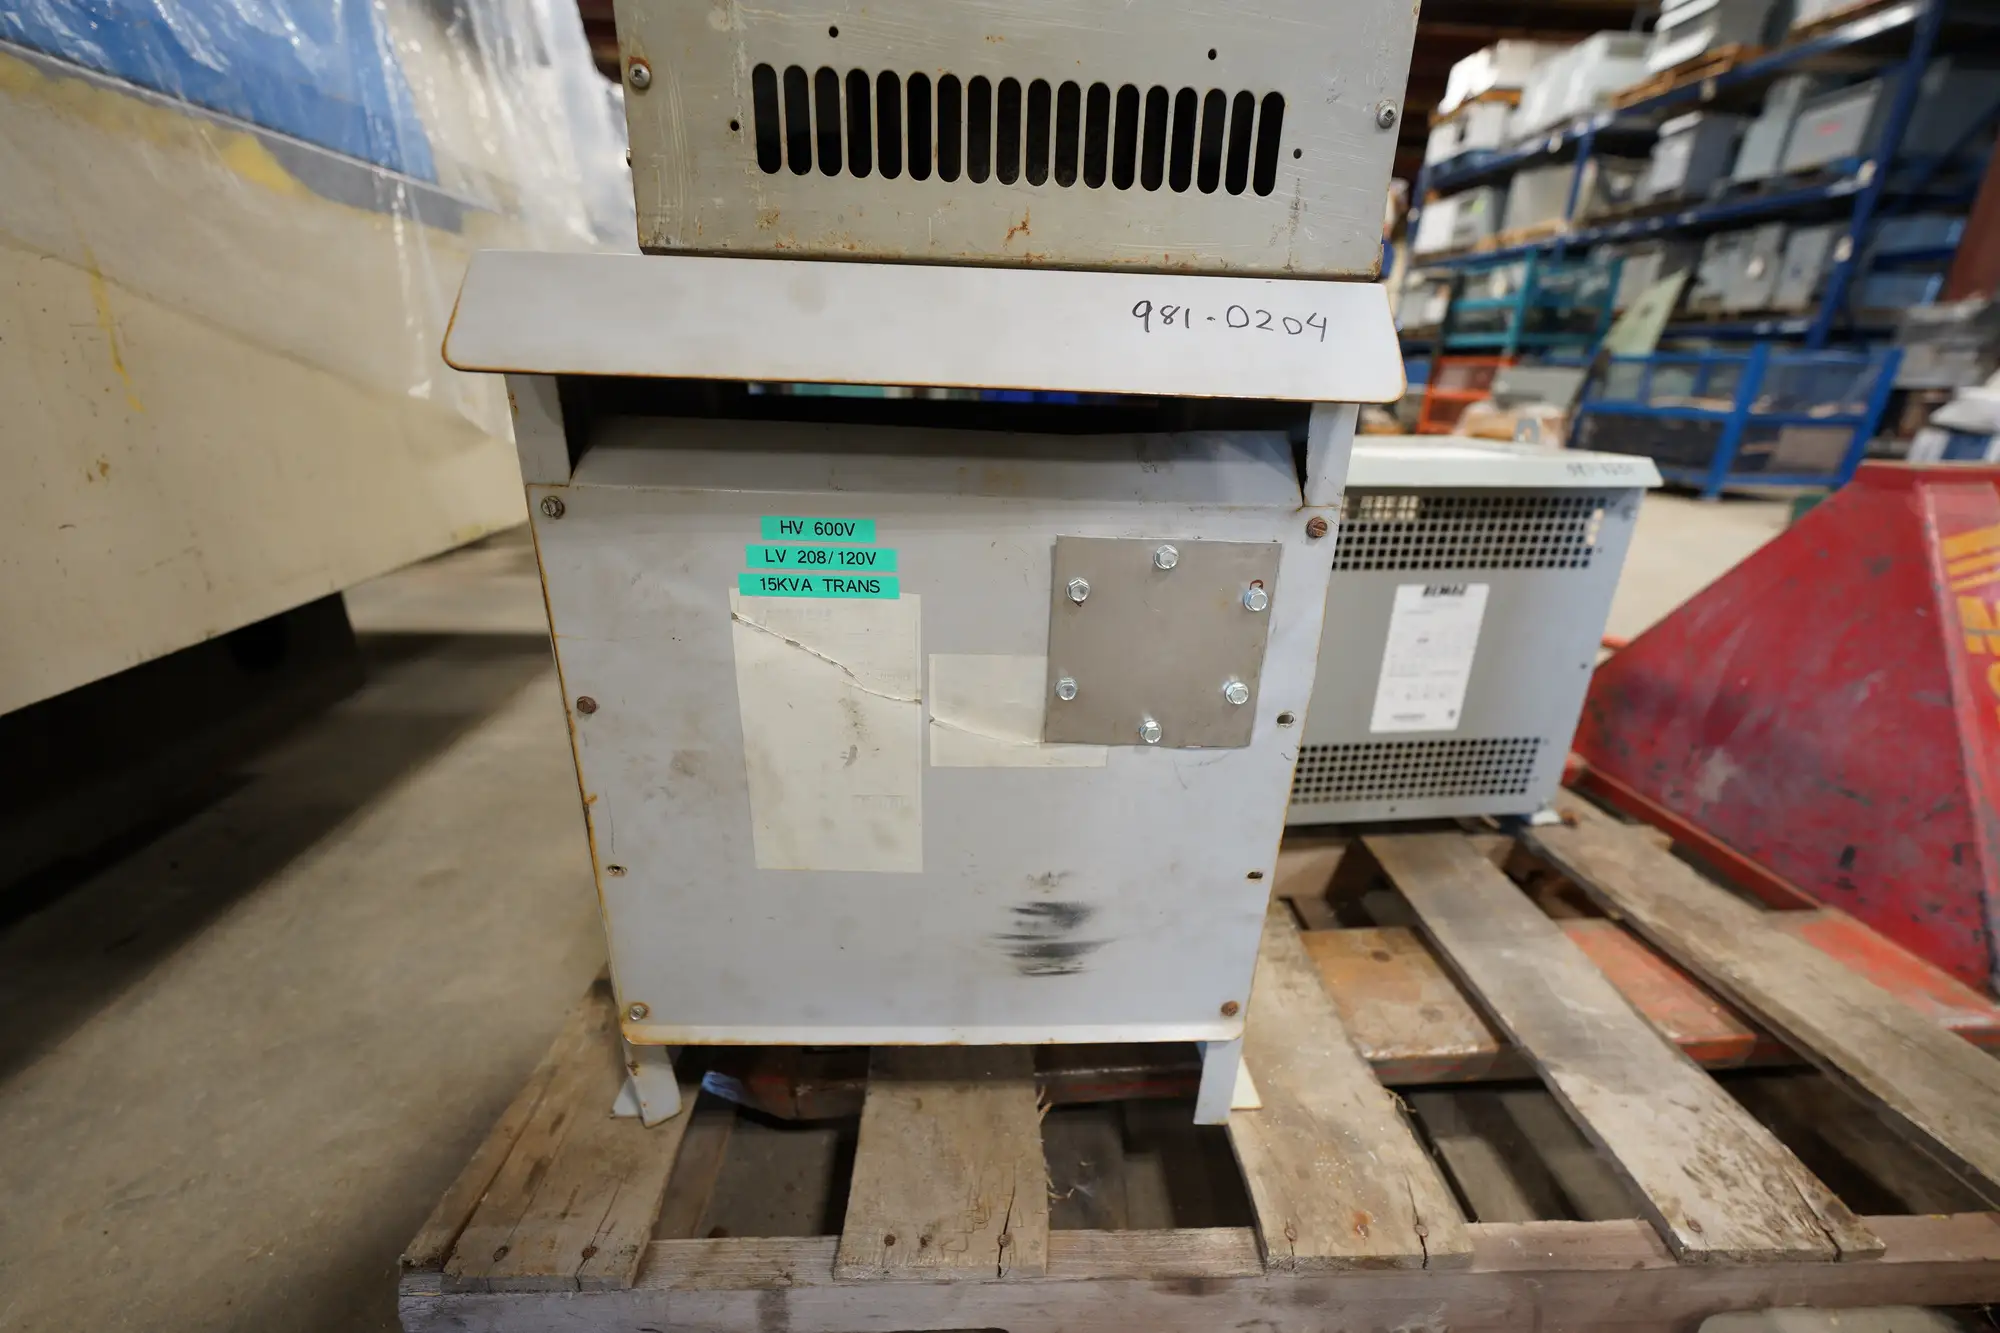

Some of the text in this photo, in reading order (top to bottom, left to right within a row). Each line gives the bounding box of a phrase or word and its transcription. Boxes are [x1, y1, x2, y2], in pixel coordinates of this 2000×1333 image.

[1132, 299, 1327, 343] 981-0204
[780, 519, 856, 537] HV 600V
[765, 549, 877, 566] LV 208/120V
[759, 577, 881, 594] 15KVA TRANS
